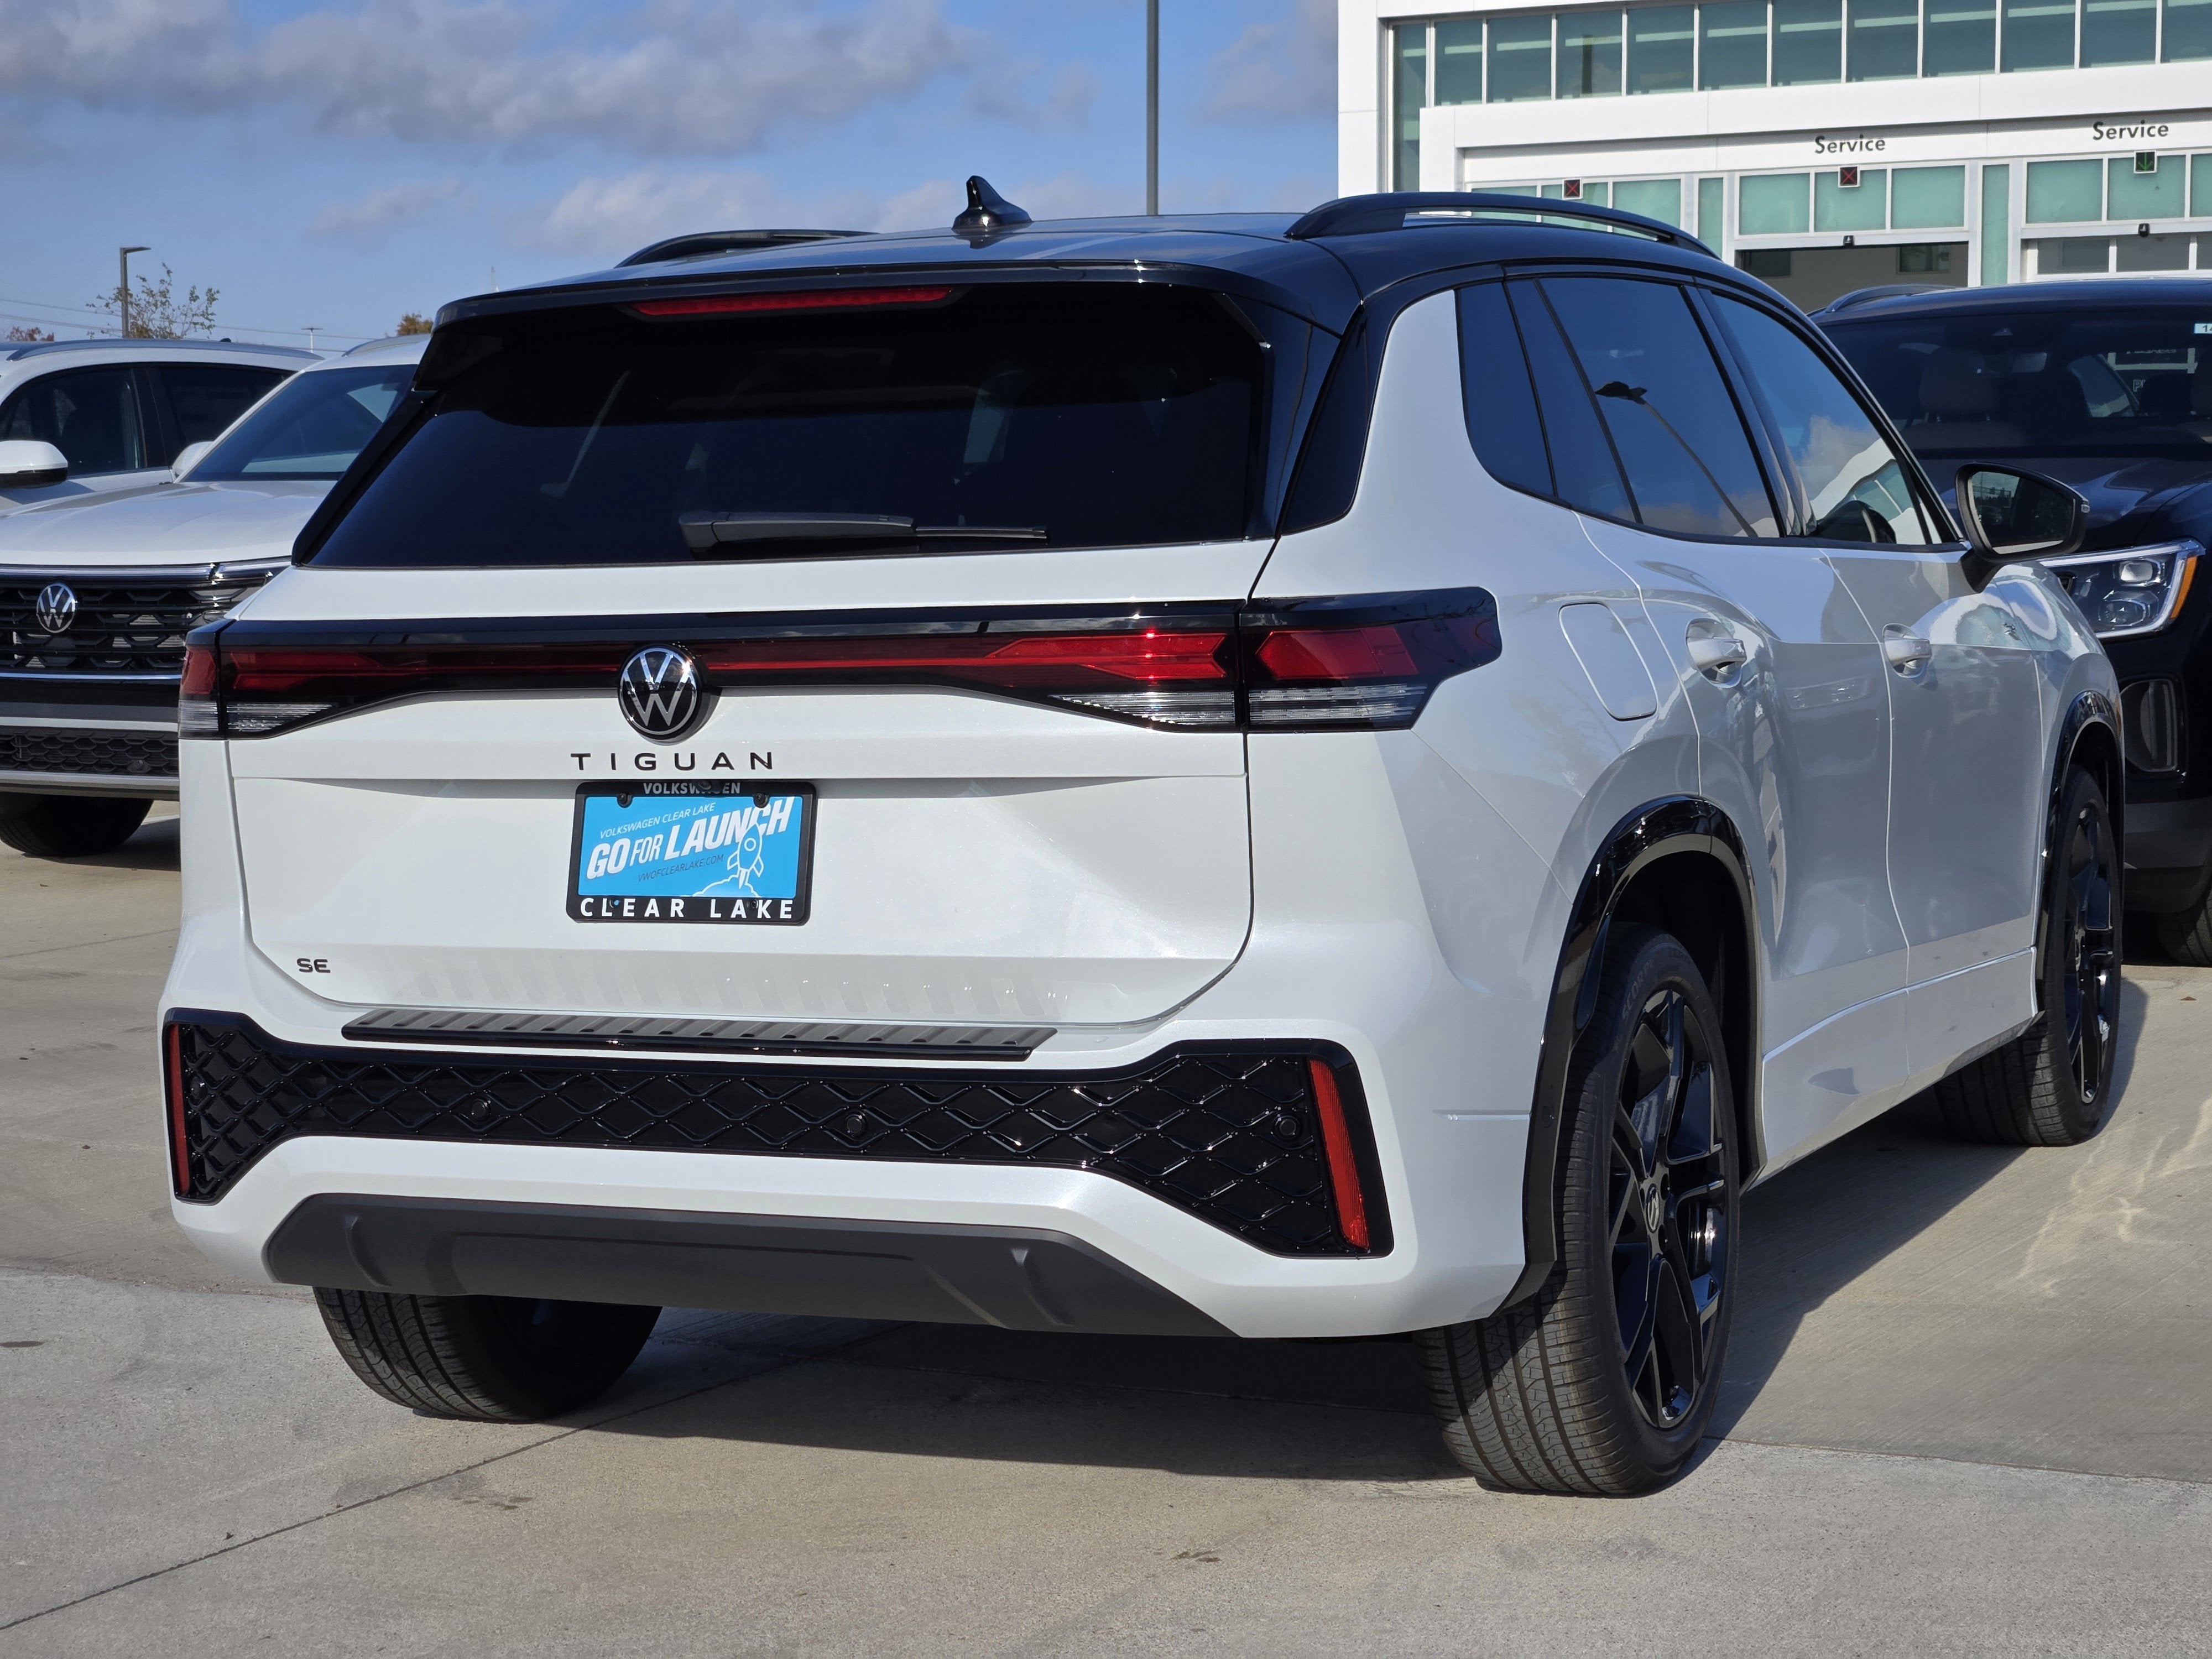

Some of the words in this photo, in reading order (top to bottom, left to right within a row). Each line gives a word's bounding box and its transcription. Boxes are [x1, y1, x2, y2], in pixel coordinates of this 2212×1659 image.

[2093, 119, 2169, 140] Service
[1815, 134, 1886, 154] Service
[622, 651, 693, 727] VW
[570, 752, 773, 771] TIGUAN
[643, 782, 740, 795] VOLKSWEN
[600, 816, 661, 839] VOLKSWAGEN
[662, 808, 691, 823] CLEAR
[692, 802, 716, 816] LAKE
[586, 838, 631, 880] GO
[629, 834, 664, 867] FOR
[664, 796, 795, 860] LAUNCH
[638, 853, 724, 882] VWOFCLEARLAKE.COM
[580, 898, 685, 918] CLEAR
[710, 899, 793, 919] LAKE
[296, 958, 331, 973] SE
